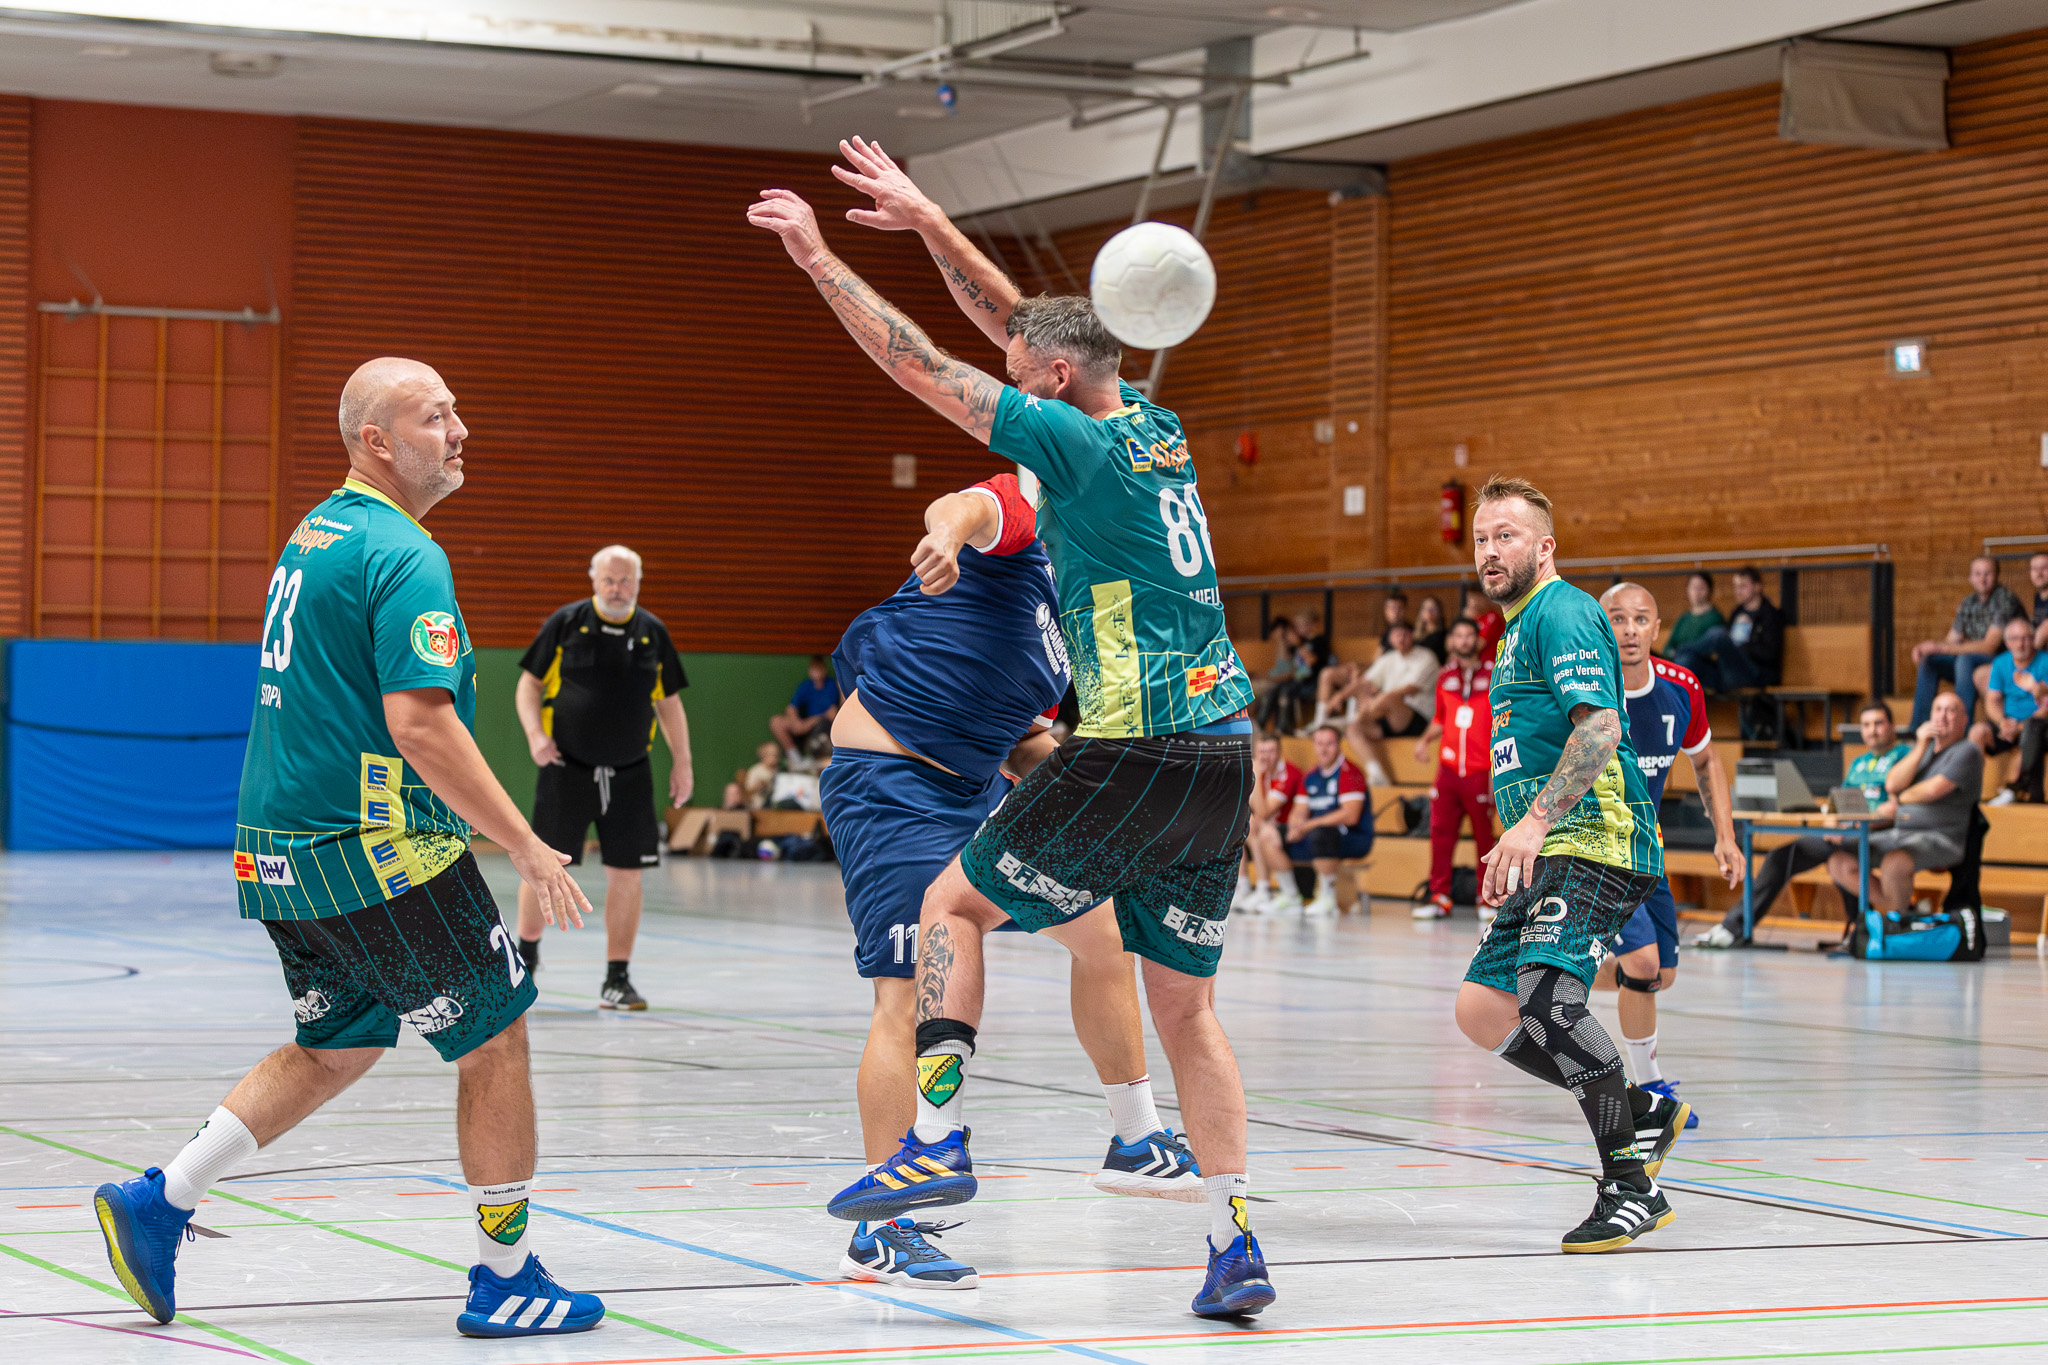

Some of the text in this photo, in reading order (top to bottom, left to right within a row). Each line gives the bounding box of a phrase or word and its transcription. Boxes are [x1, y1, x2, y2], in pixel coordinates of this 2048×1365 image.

[261, 565, 303, 672] 23
[1552, 649, 1600, 667] Unser Dorf.
[1553, 664, 1606, 684] Unser Verein.
[261, 683, 282, 709] SOPA
[1661, 714, 1675, 746] 7
[889, 923, 920, 964] 11
[922, 1064, 933, 1072] SV
[483, 1185, 526, 1195] Handball
[489, 1211, 504, 1219] SV
